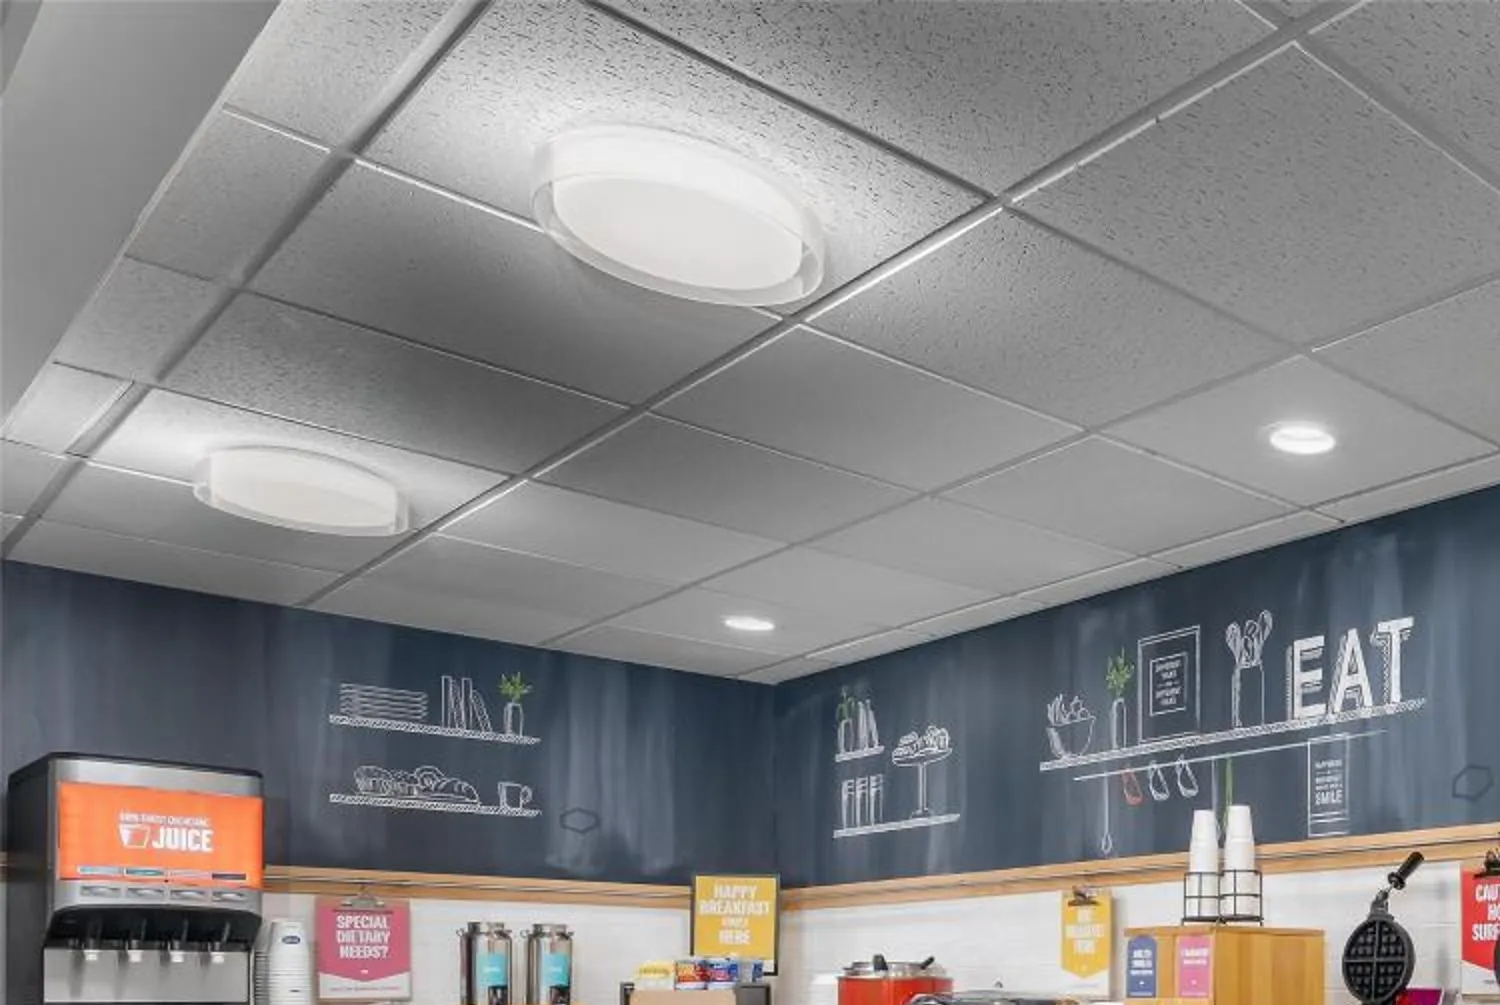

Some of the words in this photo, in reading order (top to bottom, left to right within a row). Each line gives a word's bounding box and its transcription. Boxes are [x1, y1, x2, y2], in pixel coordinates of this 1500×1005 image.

[1286, 615, 1414, 721] EAT
[1315, 790, 1343, 805] SMILE
[152, 825, 214, 852] JUICE
[713, 884, 758, 900] HAPPY
[699, 899, 770, 916] BREAKFAST
[336, 915, 389, 929] SPECIAL
